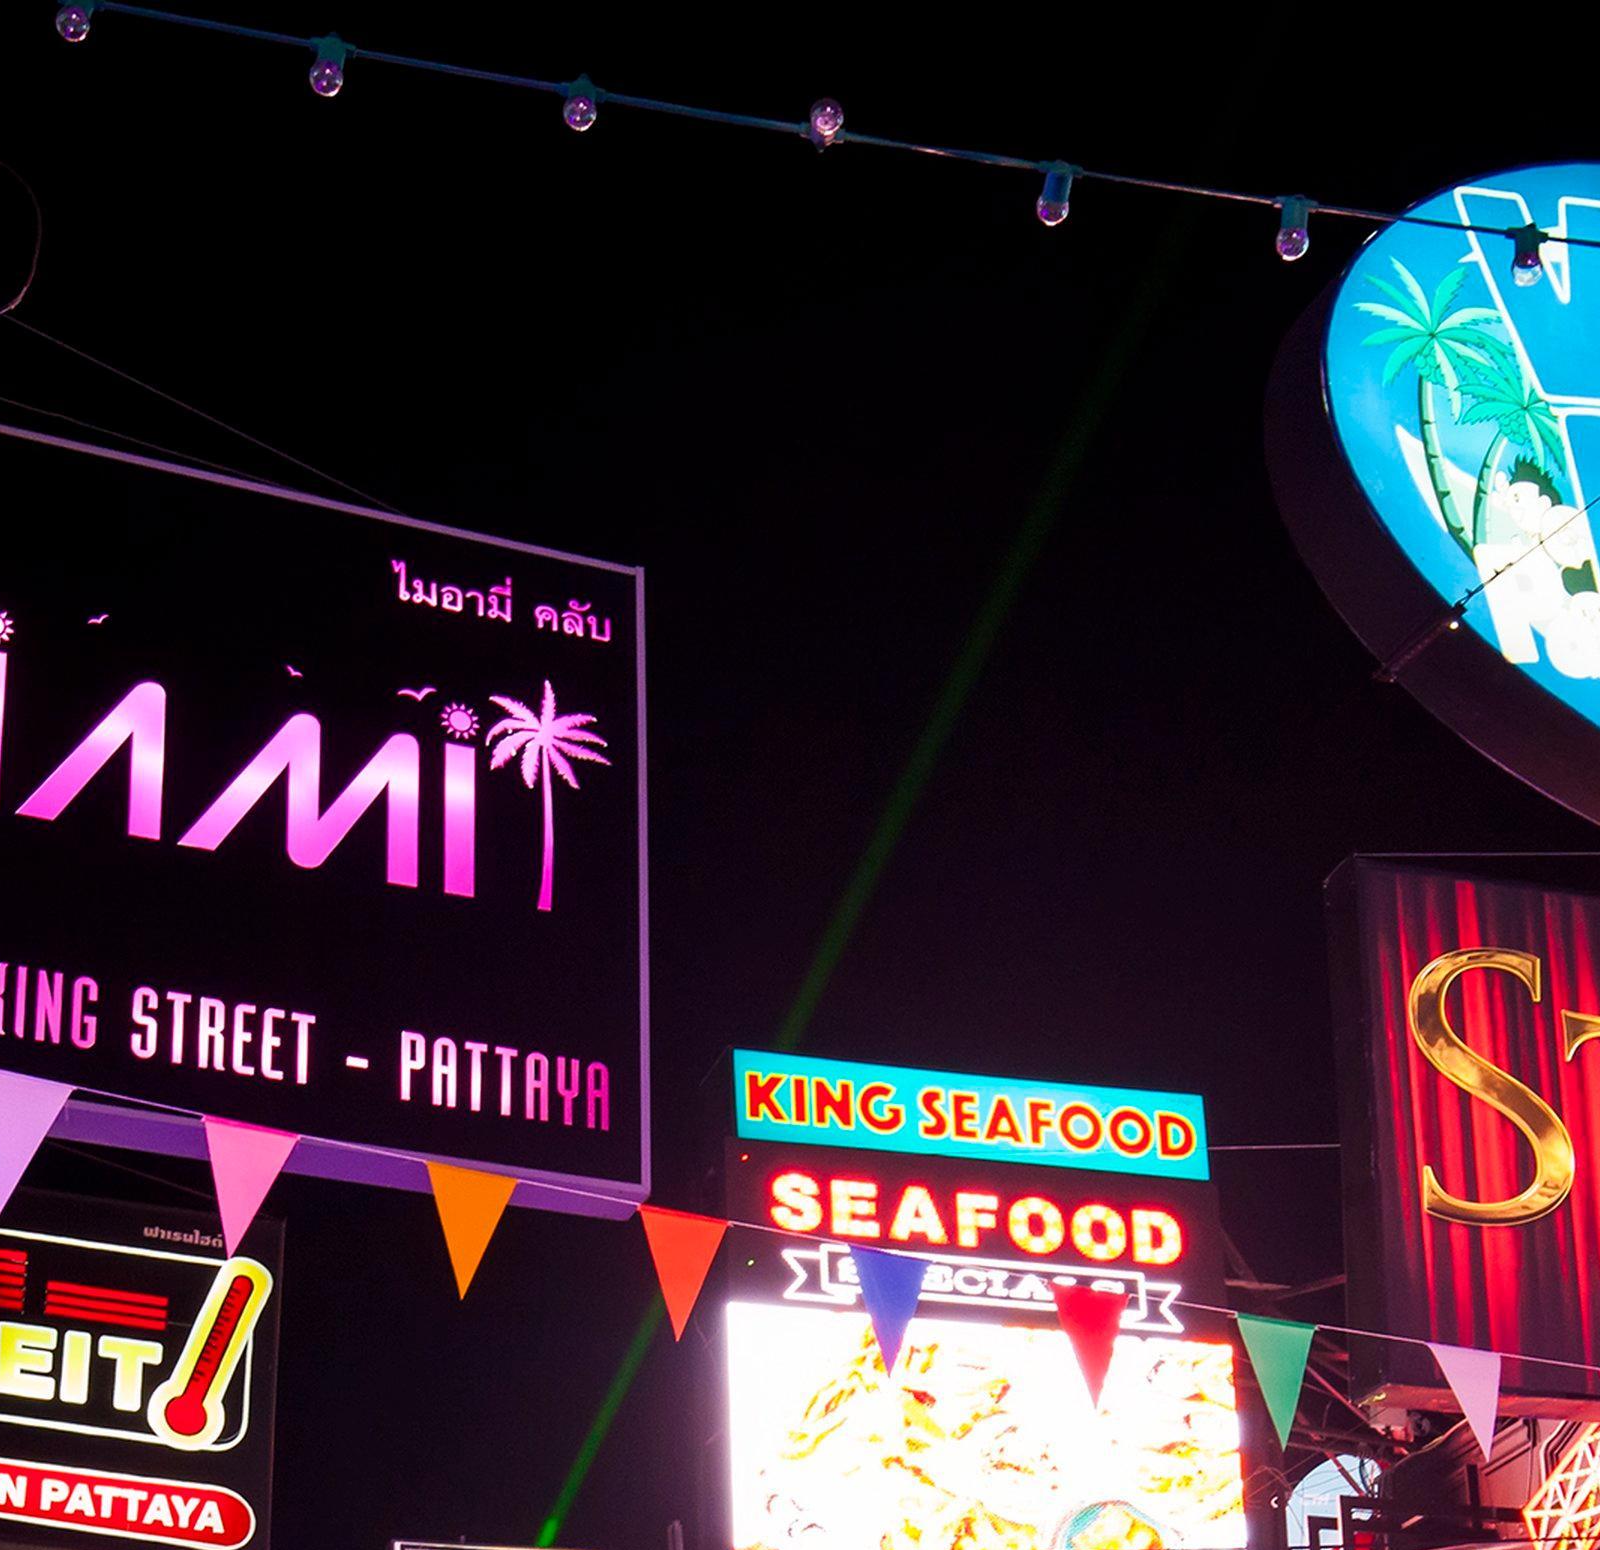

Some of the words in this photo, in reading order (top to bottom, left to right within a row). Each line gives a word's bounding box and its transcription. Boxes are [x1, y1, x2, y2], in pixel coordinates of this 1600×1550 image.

[391, 556, 514, 622] ไมอามี่
[534, 598, 612, 643] คลับ
[131, 987, 317, 1085] STREET
[400, 1029, 613, 1131] PATTAYA
[744, 1070, 904, 1132] KING
[918, 1088, 1198, 1160] SEAFOOD
[767, 1172, 1184, 1267] SEAFOOD
[39, 1479, 225, 1536] PATTAYA
